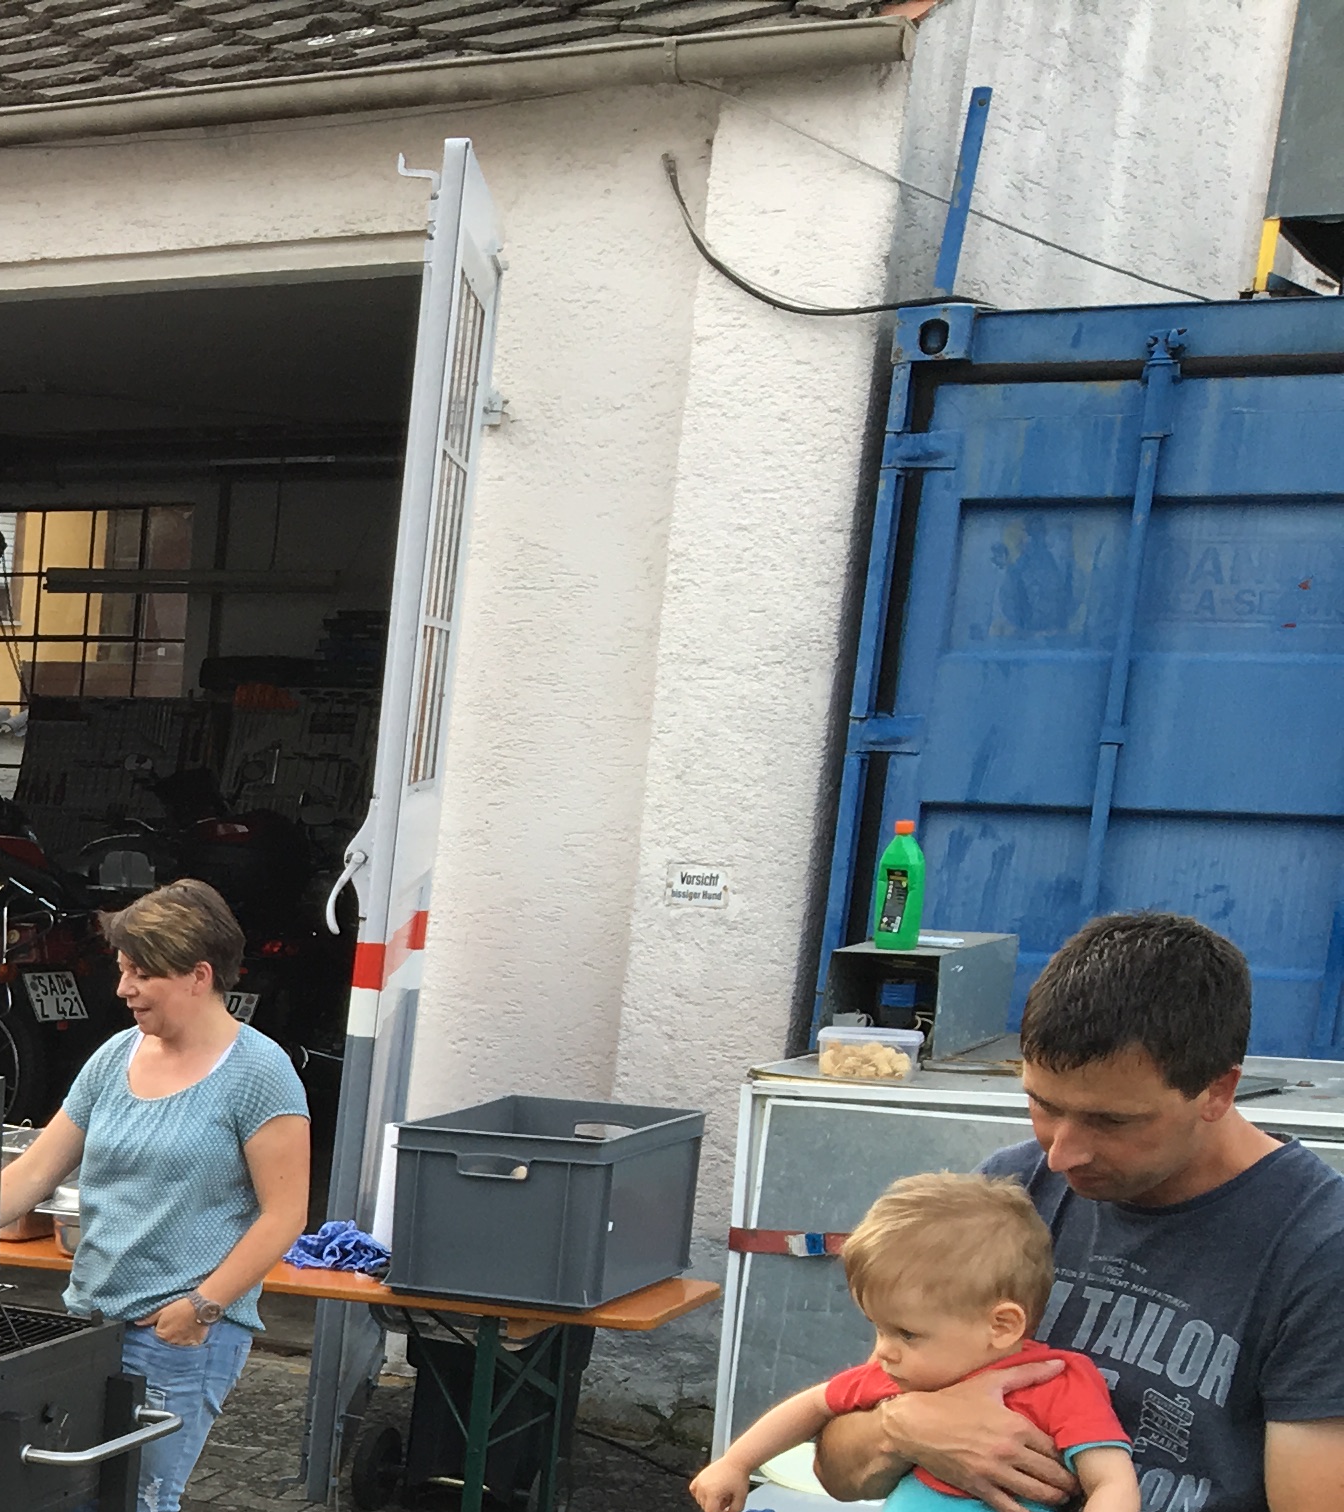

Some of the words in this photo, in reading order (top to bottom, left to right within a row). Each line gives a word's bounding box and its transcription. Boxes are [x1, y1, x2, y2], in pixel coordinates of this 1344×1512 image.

[680, 871, 720, 887] Vorsicht
[671, 888, 701, 902] bissiger
[702, 890, 722, 901] Hund
[37, 974, 67, 996] SAD
[35, 998, 50, 1019] Z
[55, 996, 85, 1017] 421
[1071, 1285, 1242, 1408] TAILOR
